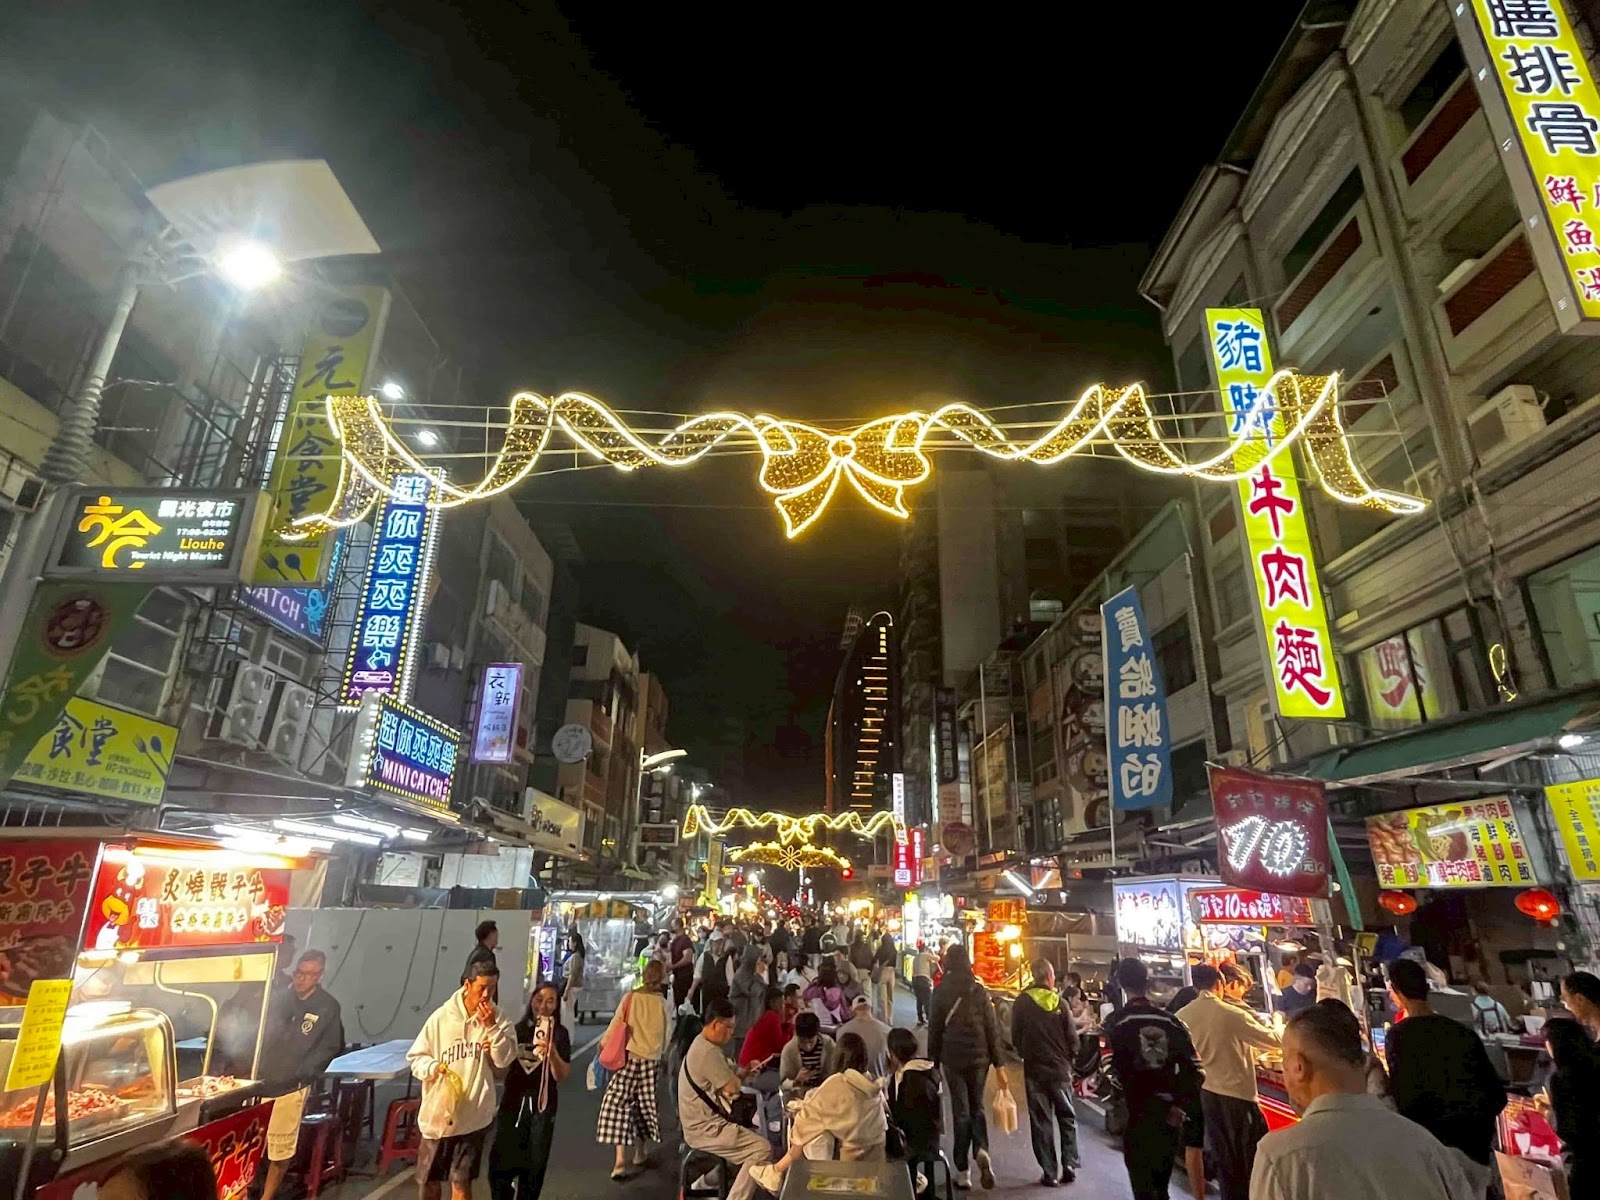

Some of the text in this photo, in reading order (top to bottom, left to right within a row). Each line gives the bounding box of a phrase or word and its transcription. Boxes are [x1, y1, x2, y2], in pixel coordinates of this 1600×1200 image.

[158, 500, 235, 517] 觀光夜市
[131, 551, 223, 562] Tourist Night Market
[180, 538, 225, 549] Liouhe
[363, 474, 427, 647] 迷你夾夾樂
[48, 710, 118, 767] 食堂
[378, 711, 455, 775] 迷你夾夾樂
[162, 868, 264, 902] 炙燒骰子牛
[441, 1042, 486, 1066] CHICAG
